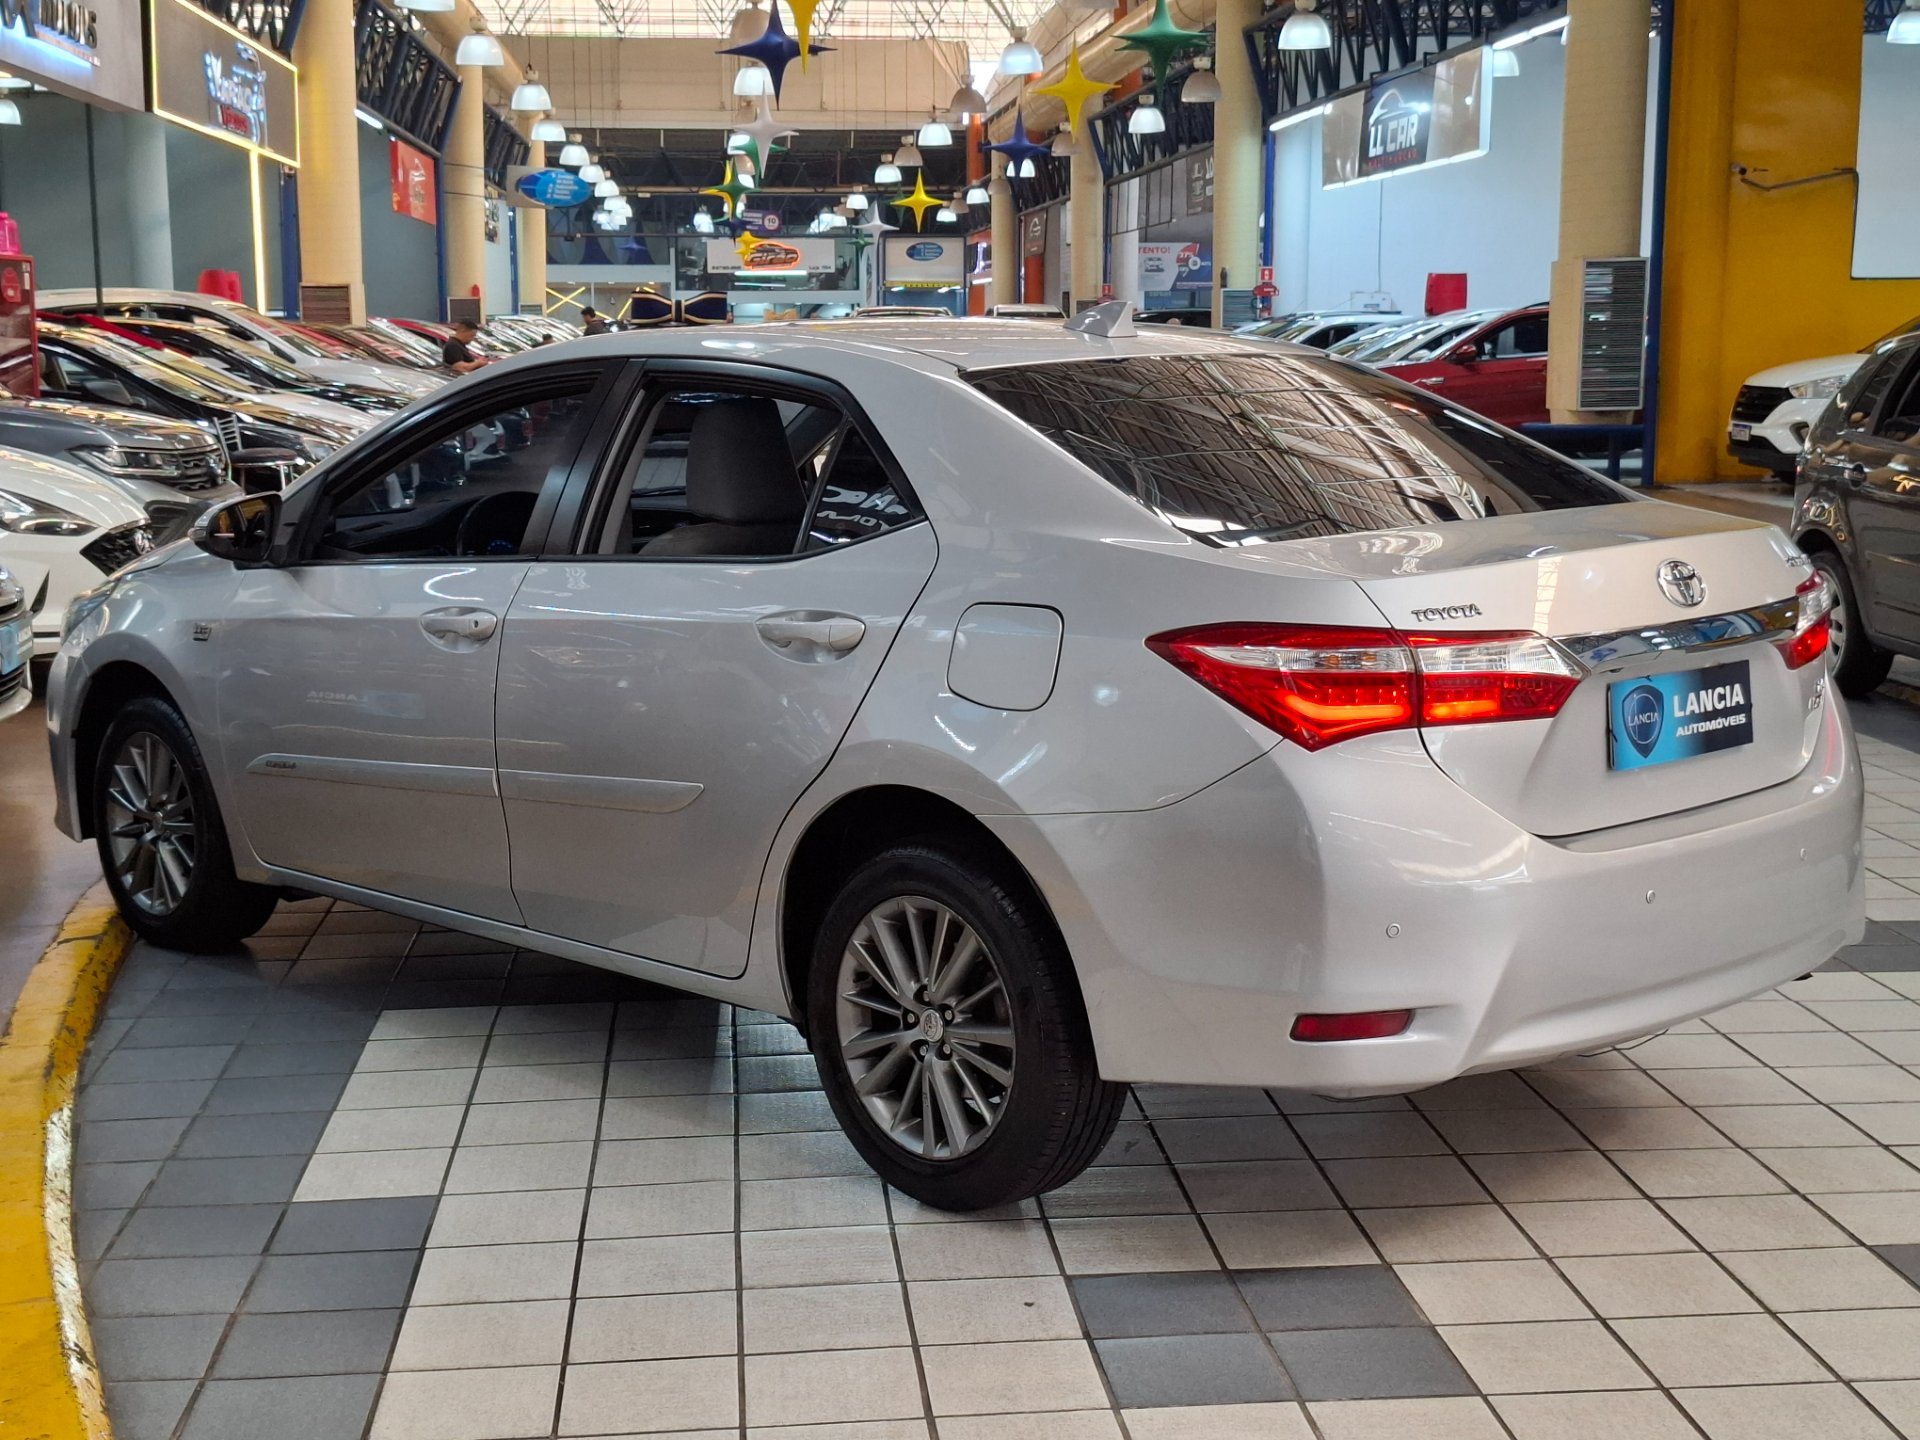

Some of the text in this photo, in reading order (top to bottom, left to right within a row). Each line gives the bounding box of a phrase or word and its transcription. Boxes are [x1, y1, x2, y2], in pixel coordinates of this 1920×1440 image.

[1386, 113, 1418, 152] CAR
[1411, 603, 1482, 622] TOYOTA
[1673, 683, 1745, 718] LANCIA
[1628, 711, 1660, 727] LANCIA
[1676, 713, 1746, 737] AUTOMÓVEIS
